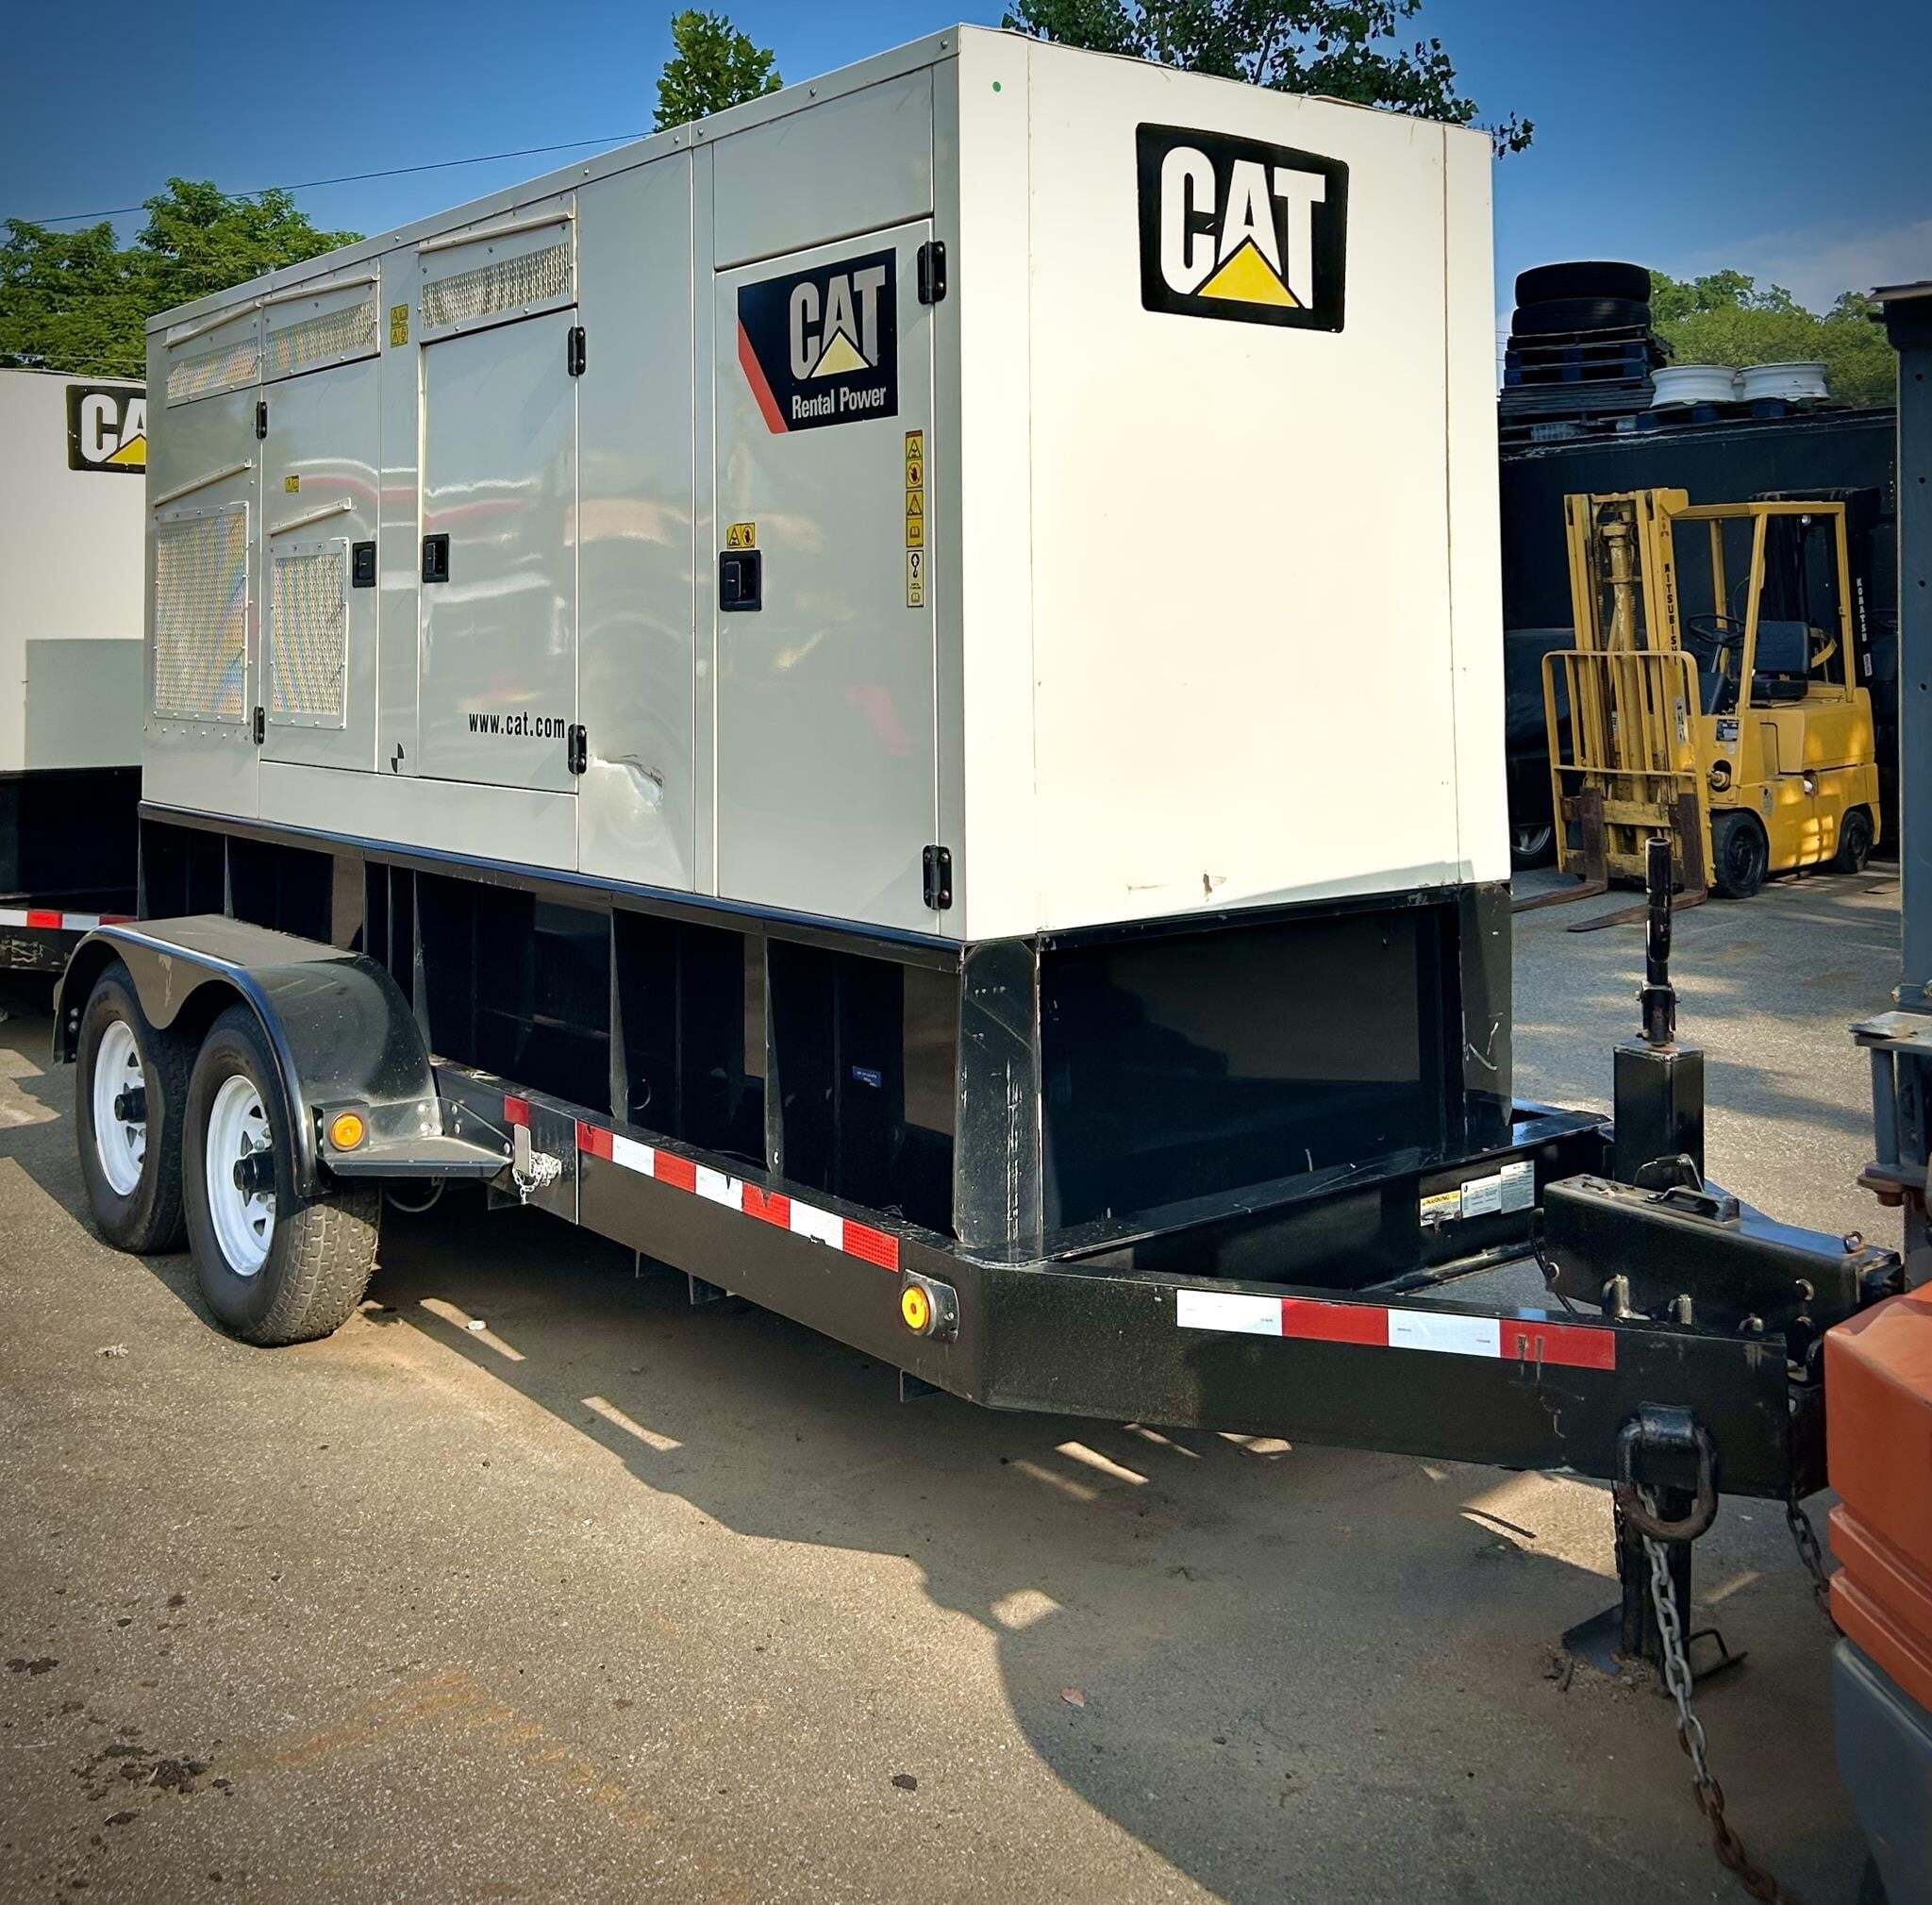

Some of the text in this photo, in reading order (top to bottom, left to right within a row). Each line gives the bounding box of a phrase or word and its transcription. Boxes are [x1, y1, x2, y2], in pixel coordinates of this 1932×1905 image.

[1160, 145, 1325, 309] CAT
[790, 264, 886, 380] CAT
[81, 393, 146, 463] CA
[791, 386, 887, 420] Rental Power
[469, 711, 565, 739] www.cat.com
